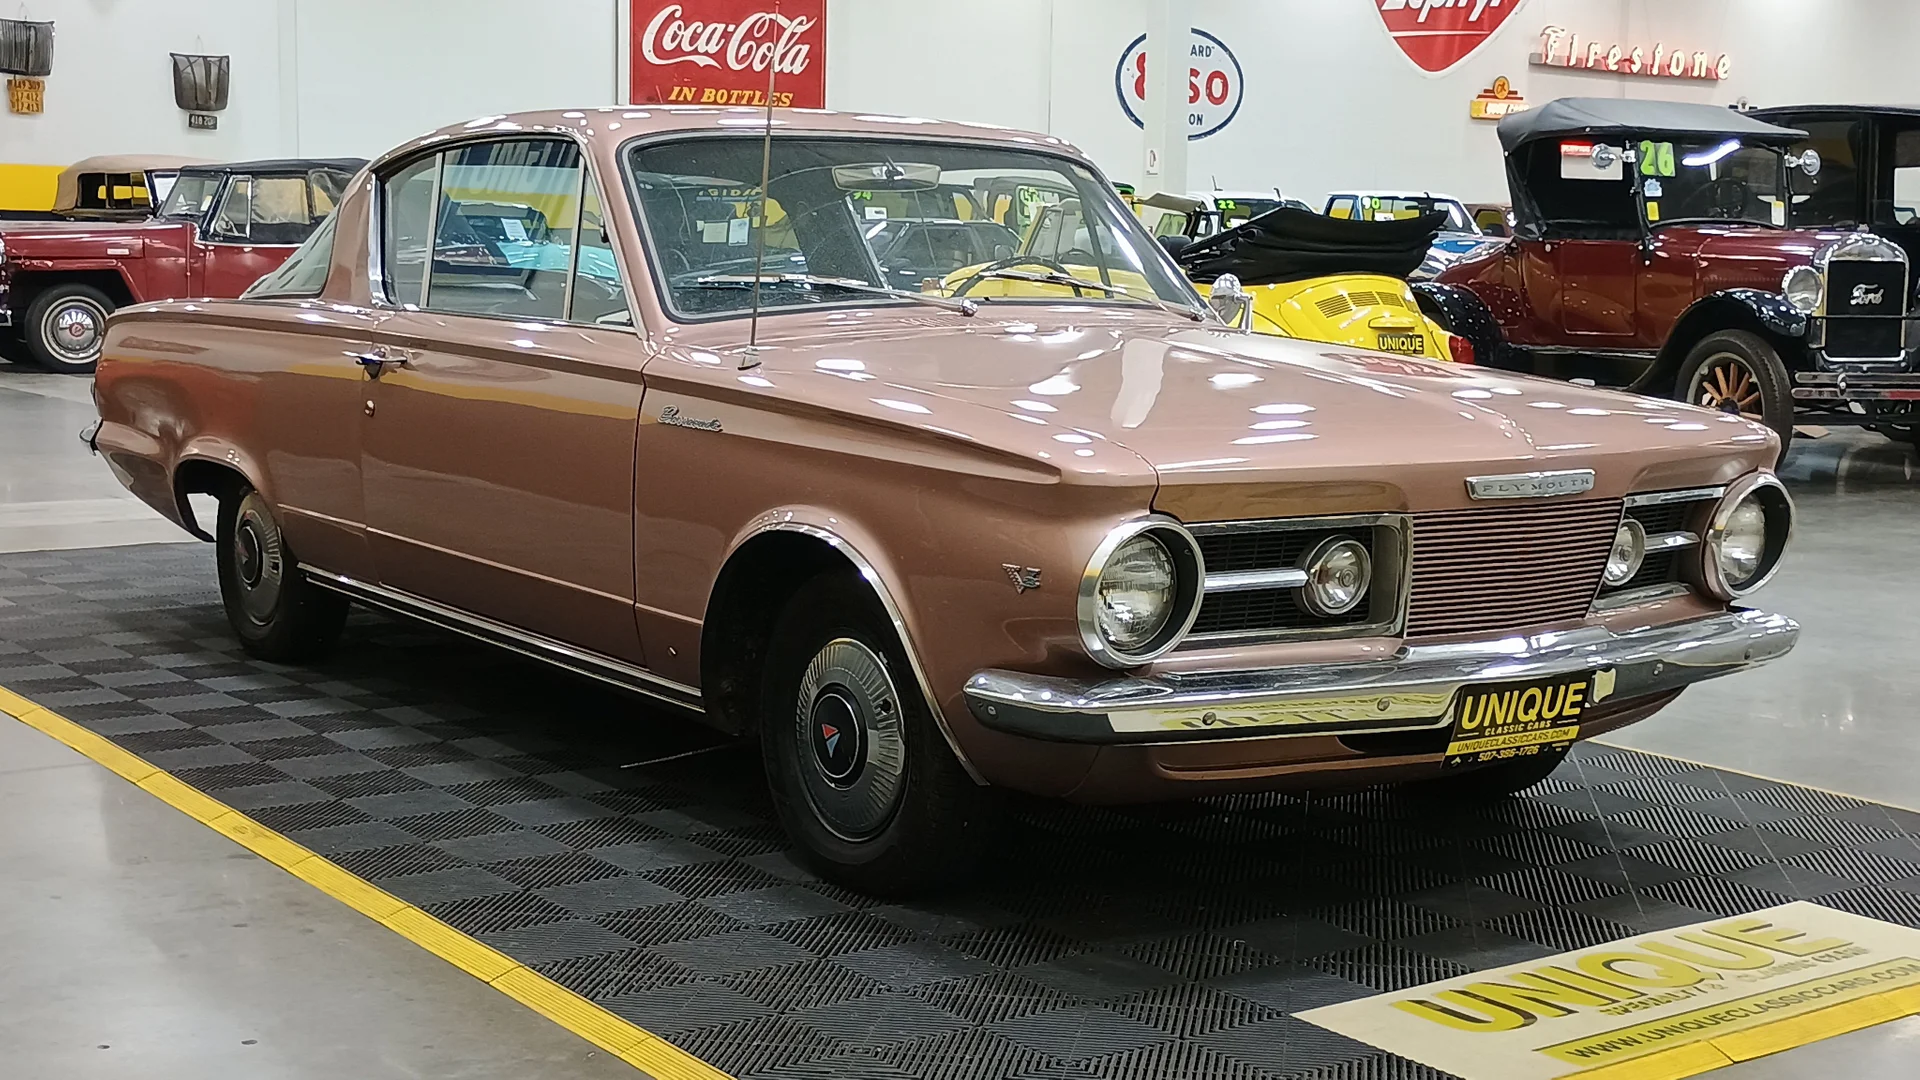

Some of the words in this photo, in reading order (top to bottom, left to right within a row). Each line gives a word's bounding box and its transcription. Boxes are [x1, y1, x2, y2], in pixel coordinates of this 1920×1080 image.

[642, 4, 818, 75] Coca-Cola
[1540, 25, 1731, 80] Firestone
[668, 86, 697, 101] IN
[700, 88, 794, 107] BOTTLES
[1640, 140, 1674, 177] 26
[1217, 200, 1236, 210] 22
[1850, 283, 1884, 306] Ford
[1379, 336, 1423, 350] UNIQUE
[1482, 477, 1590, 493] PLYMOUTH
[1461, 681, 1587, 730] UNIQUE
[1484, 723, 1524, 736] CLASSIC
[1527, 720, 1552, 731] CARS
[1390, 917, 1854, 1032] UNIQUE
